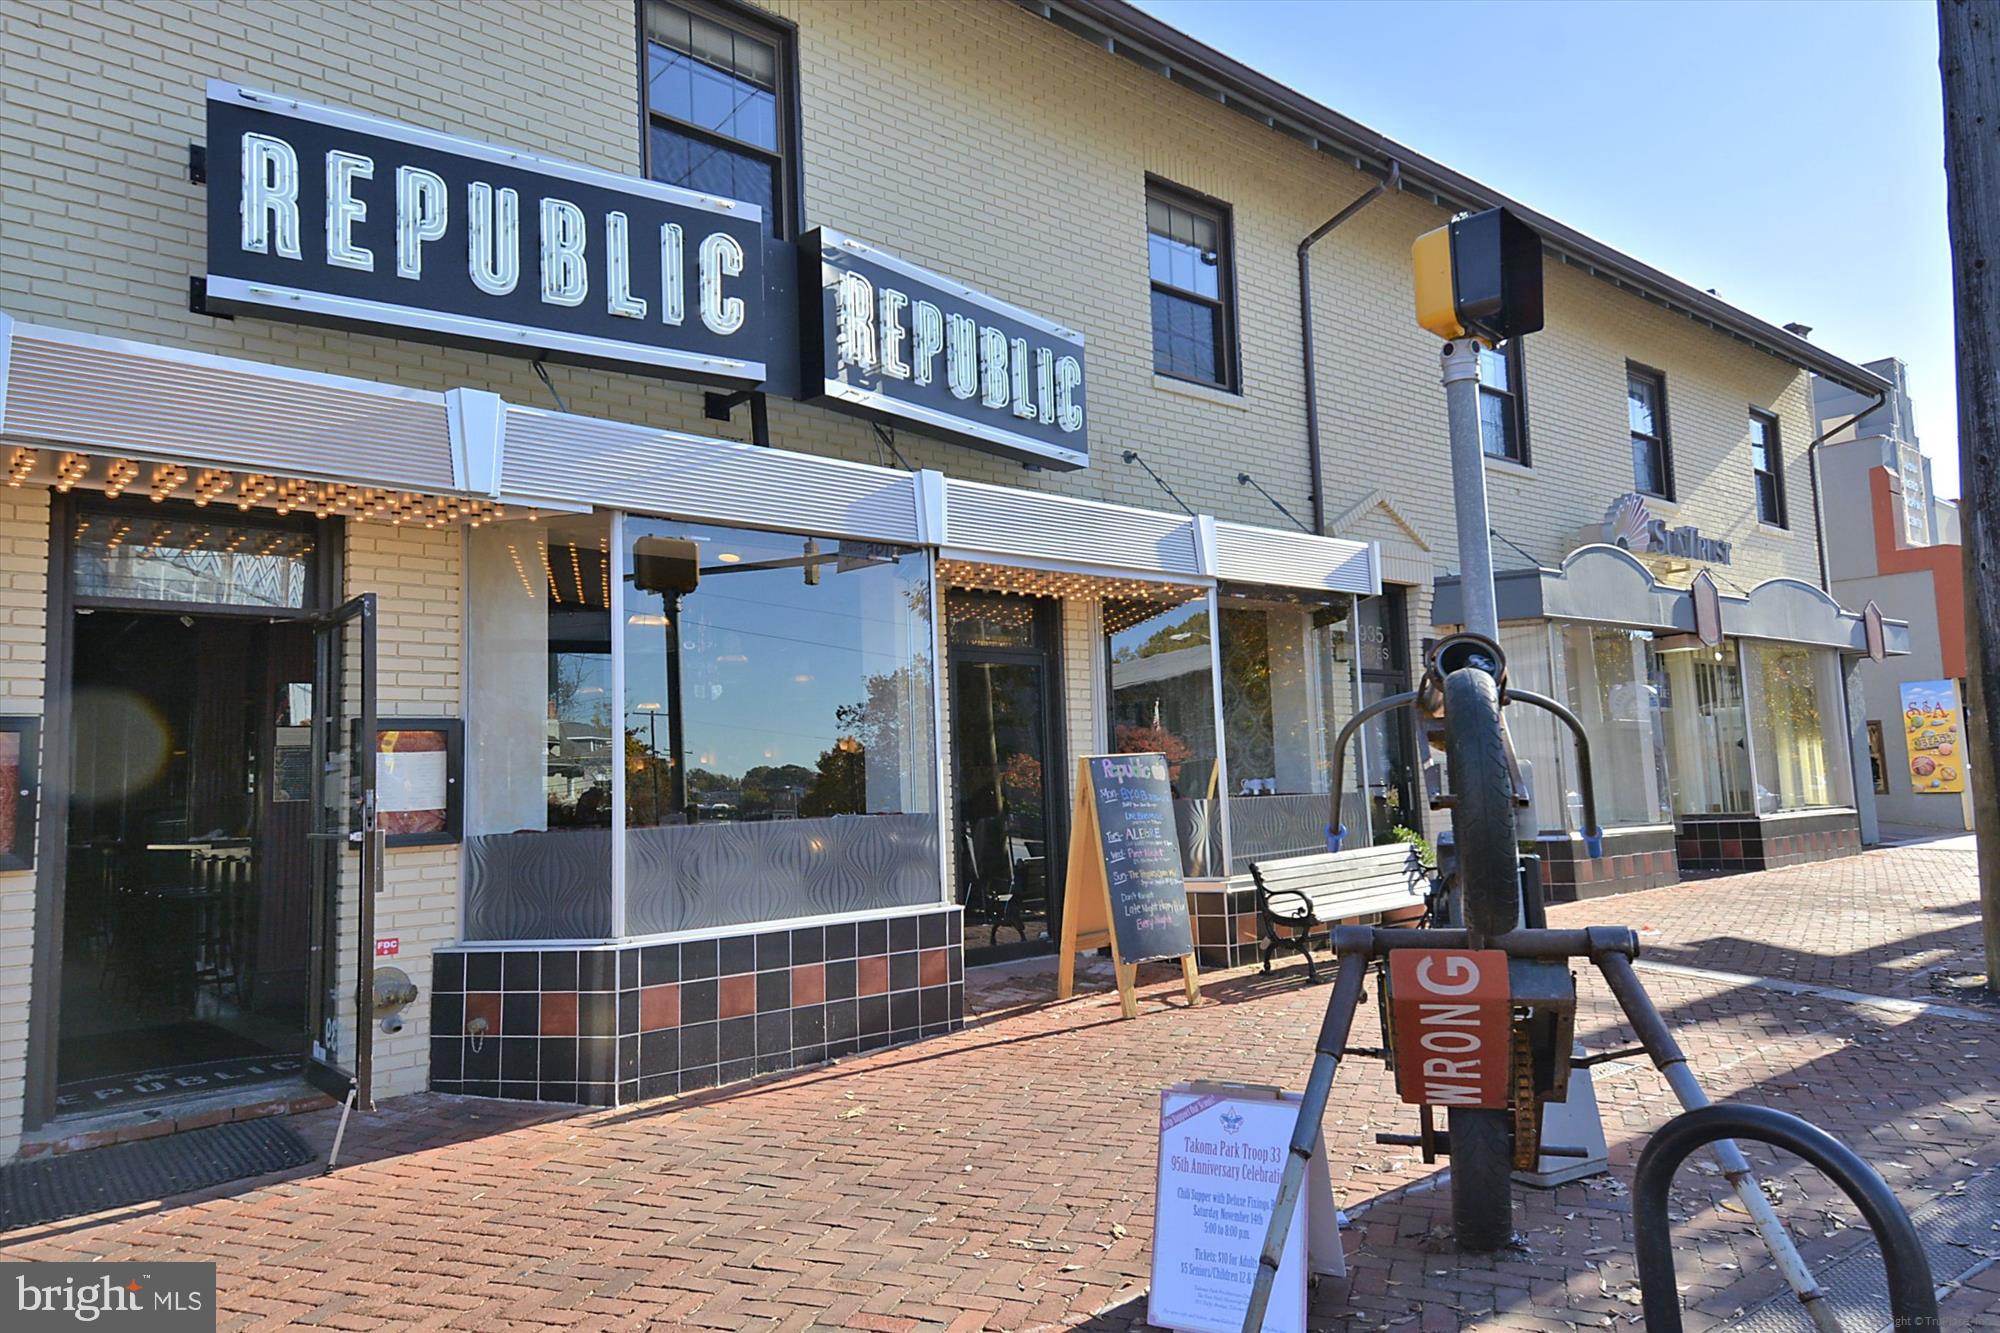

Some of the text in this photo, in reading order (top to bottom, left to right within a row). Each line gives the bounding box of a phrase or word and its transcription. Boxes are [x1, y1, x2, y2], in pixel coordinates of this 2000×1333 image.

[241, 131, 745, 335] REPUBLIC
[838, 271, 1082, 432] REPUBLIC
[1102, 758, 1151, 784] Republic
[1124, 903, 1141, 916] Late
[377, 940, 398, 949] FDC
[1416, 955, 1483, 1105] WRONG
[57, 1060, 302, 1105] EPUBLIC
[1184, 1136, 1281, 1167] Takoma Park Troop 33
[1171, 1155, 1282, 1185] 95th Anniversary Celebrati
[1204, 1222, 1217, 1235] 5:00
[1217, 1224, 1224, 1236] to
[1224, 1225, 1238, 1237] 8:00
[1220, 1208, 1250, 1223] November
[1250, 1212, 1263, 1225] 14th
[1229, 1253, 1238, 1265] for
